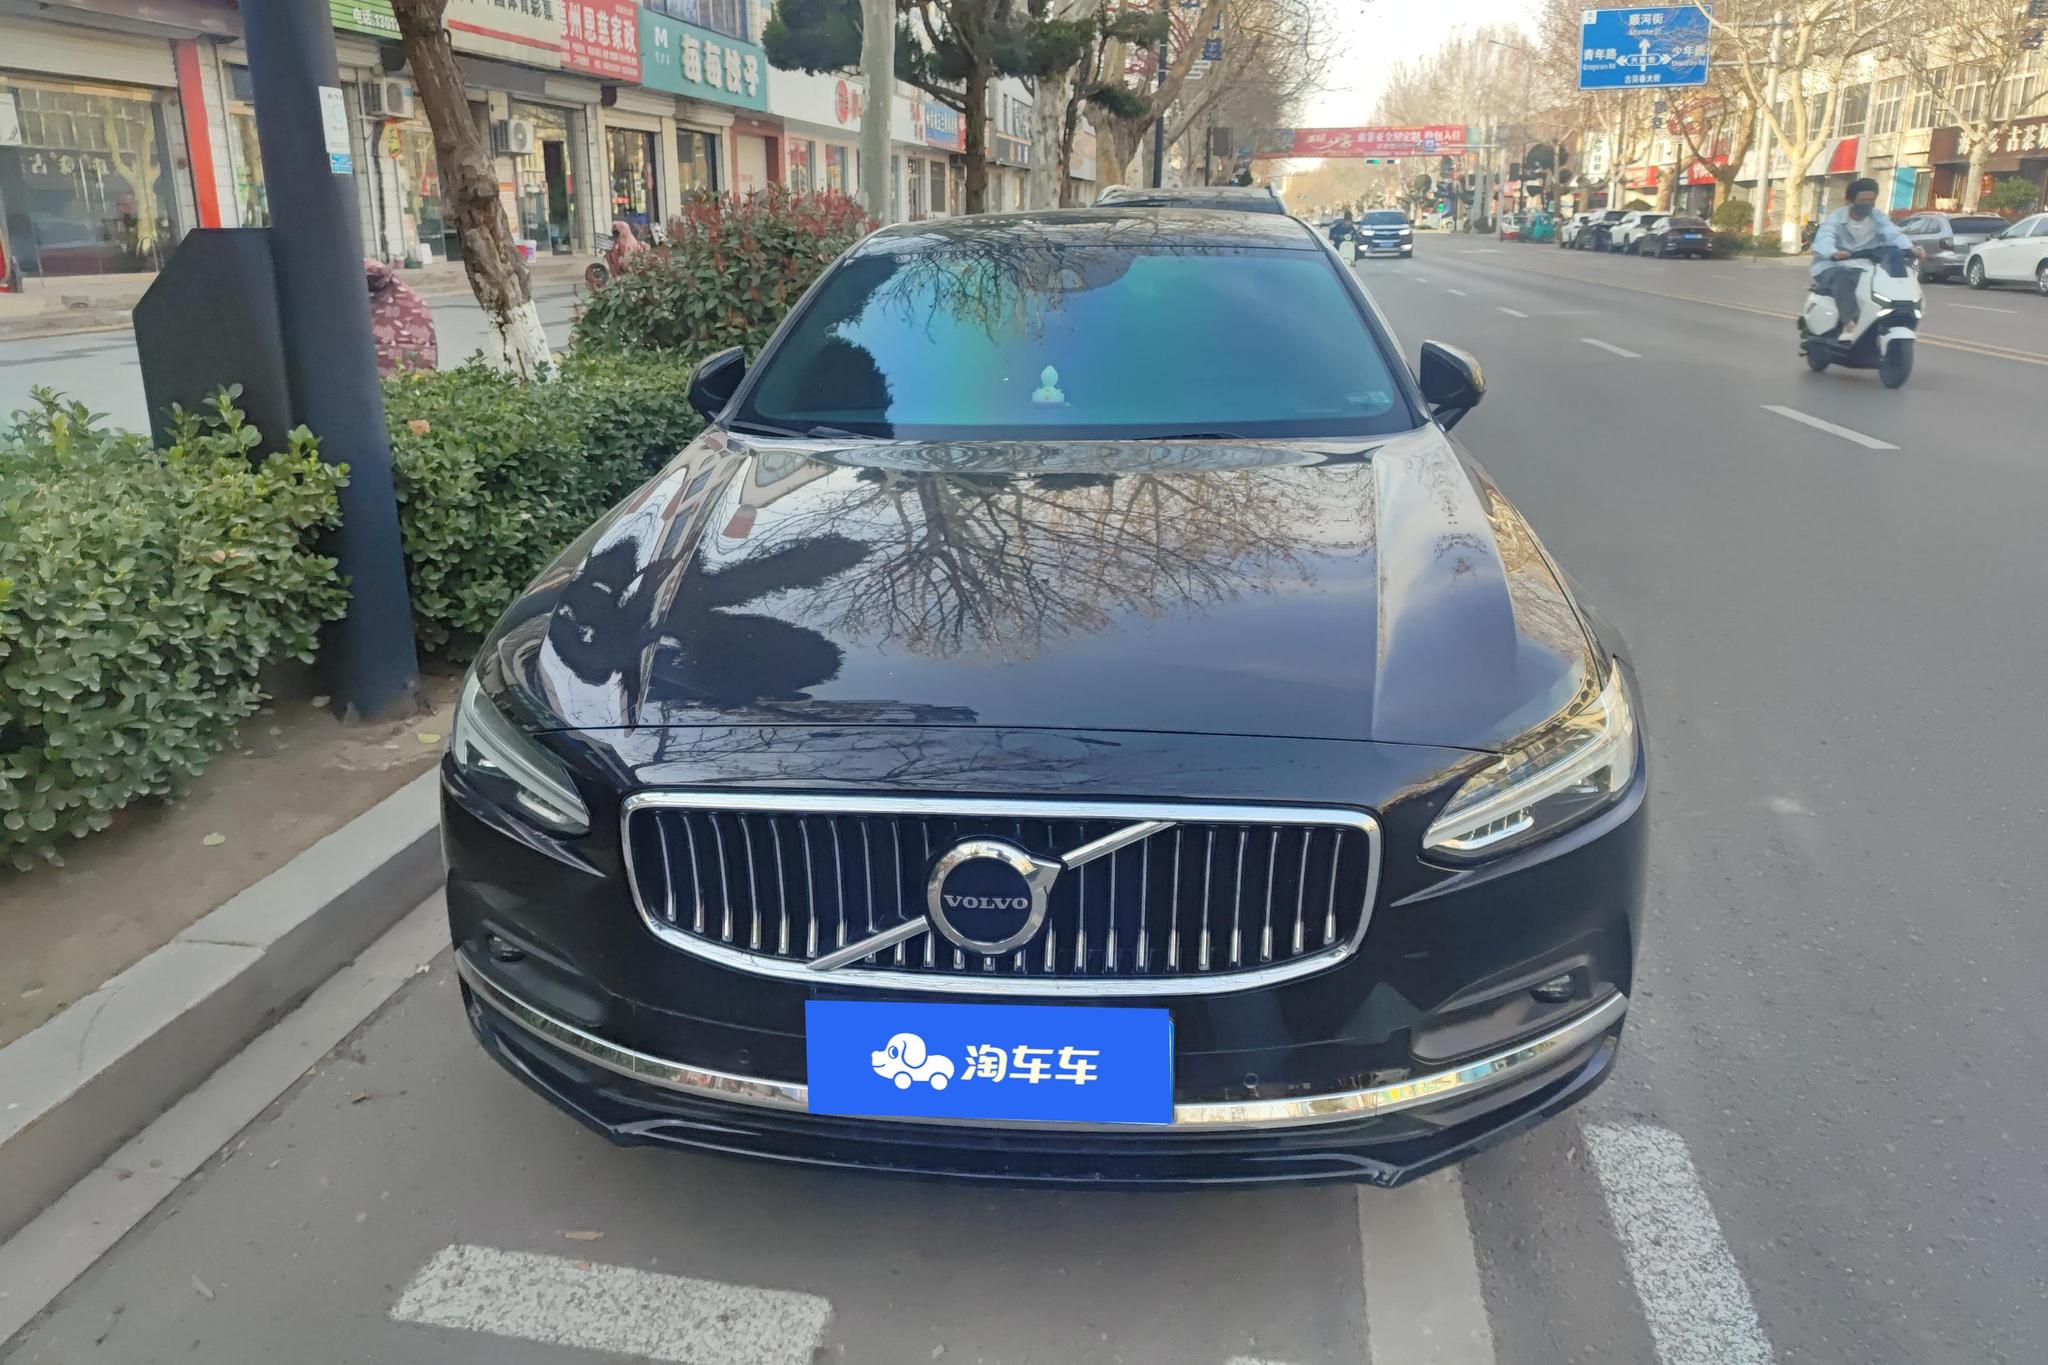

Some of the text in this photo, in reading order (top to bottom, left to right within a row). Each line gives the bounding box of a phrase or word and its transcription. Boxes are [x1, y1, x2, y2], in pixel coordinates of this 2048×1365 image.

[654, 26, 669, 49] M
[1584, 48, 1617, 61] 青年路
[944, 895, 1029, 910] VOLVO
